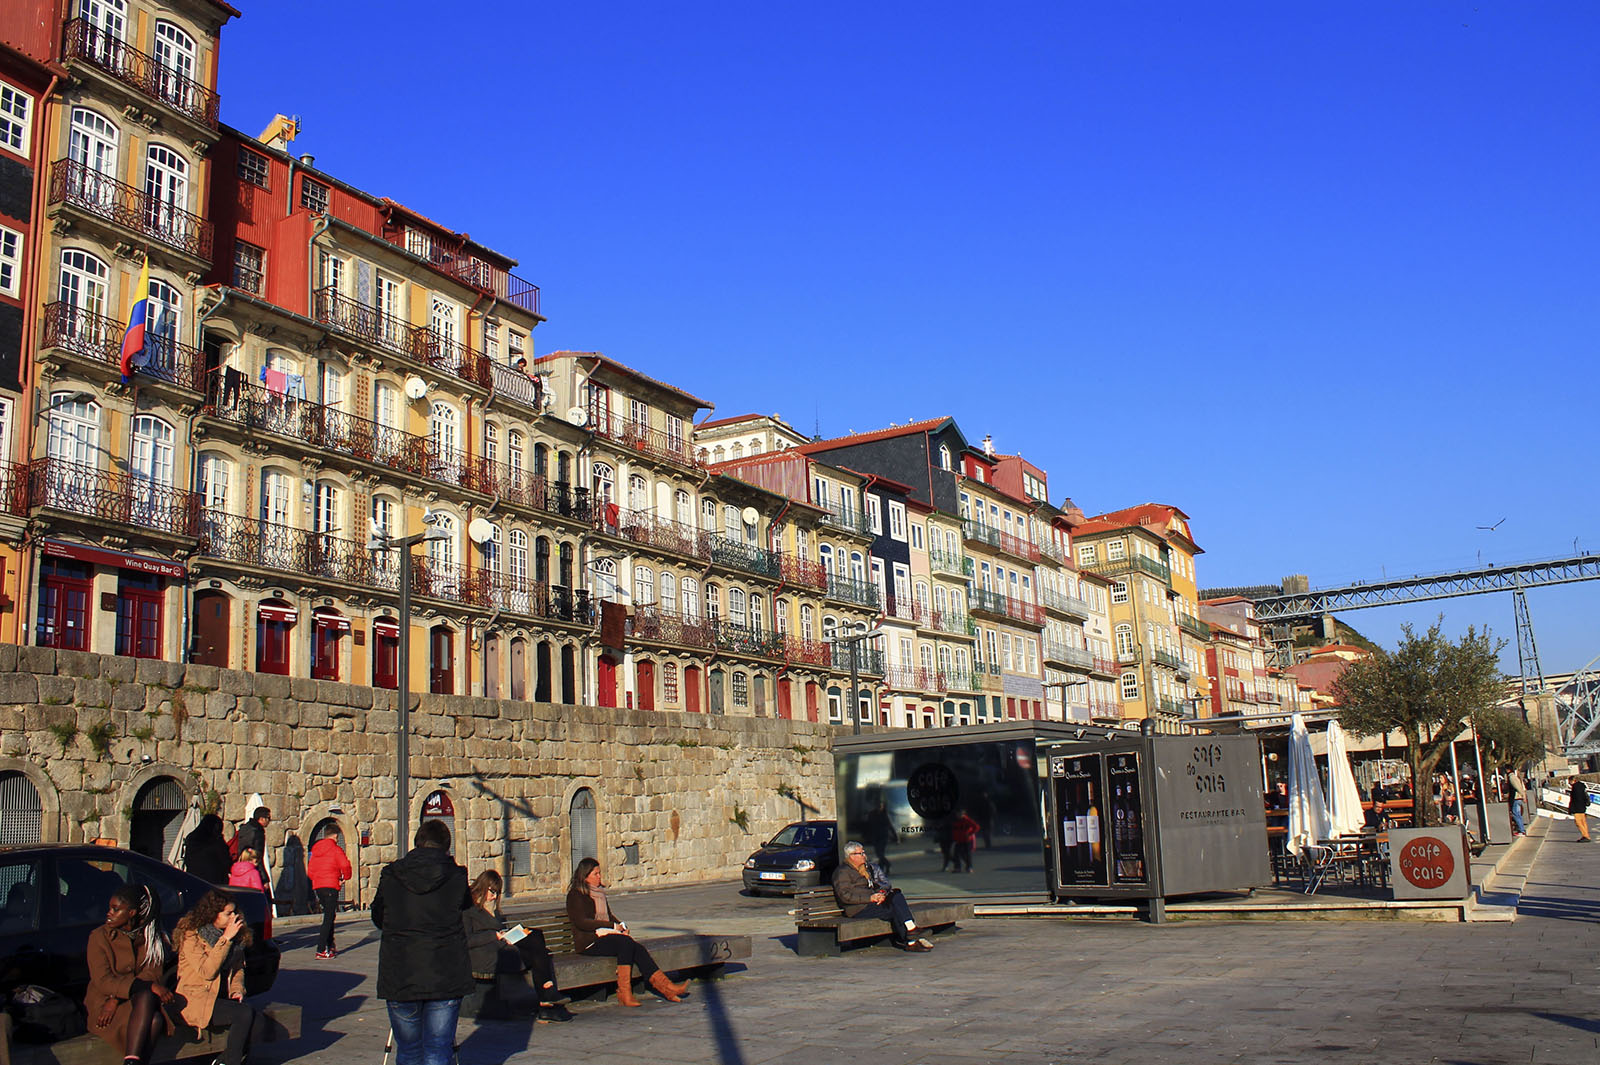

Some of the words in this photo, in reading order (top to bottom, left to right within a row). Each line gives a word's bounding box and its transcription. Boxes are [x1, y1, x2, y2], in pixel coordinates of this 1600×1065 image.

[124, 558, 143, 569] Wine
[143, 561, 160, 573] Quay
[160, 565, 173, 574] Bar
[1186, 762, 1196, 776] do
[1180, 809, 1230, 820] RESTAURANTE
[1231, 808, 1247, 817] BAR
[1402, 858, 1413, 868] do
[1412, 866, 1444, 880] cais
[710, 940, 732, 961] 23
